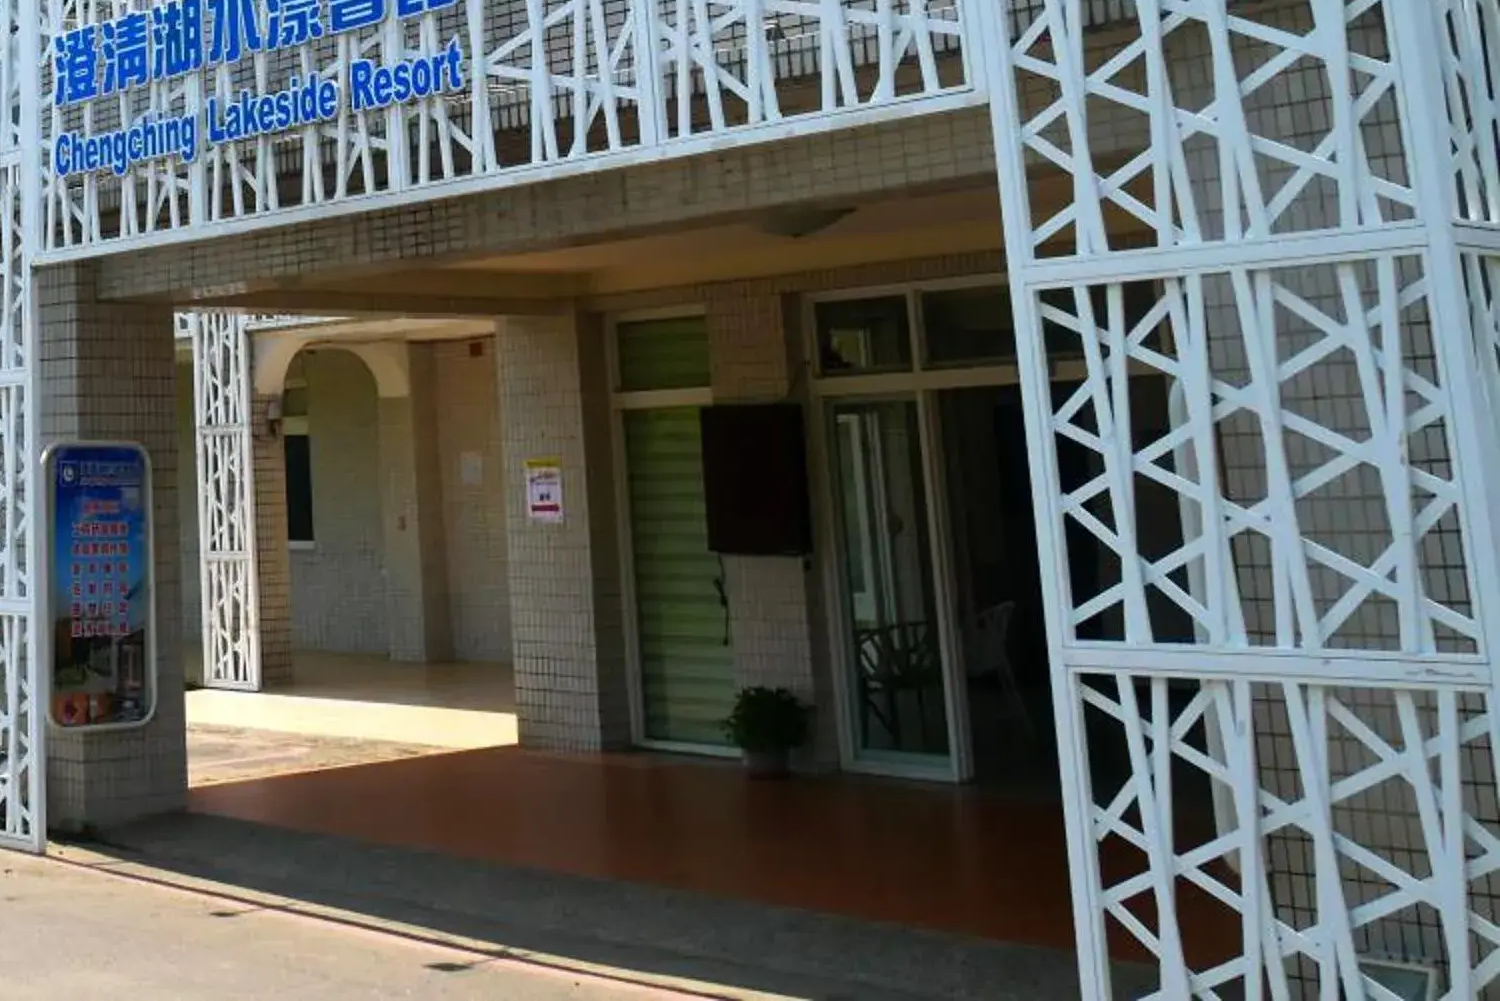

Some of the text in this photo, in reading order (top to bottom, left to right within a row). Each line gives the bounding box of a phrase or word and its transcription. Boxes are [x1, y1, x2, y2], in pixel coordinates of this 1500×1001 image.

[55, 41, 462, 177] Chengching Lakeside Resort
